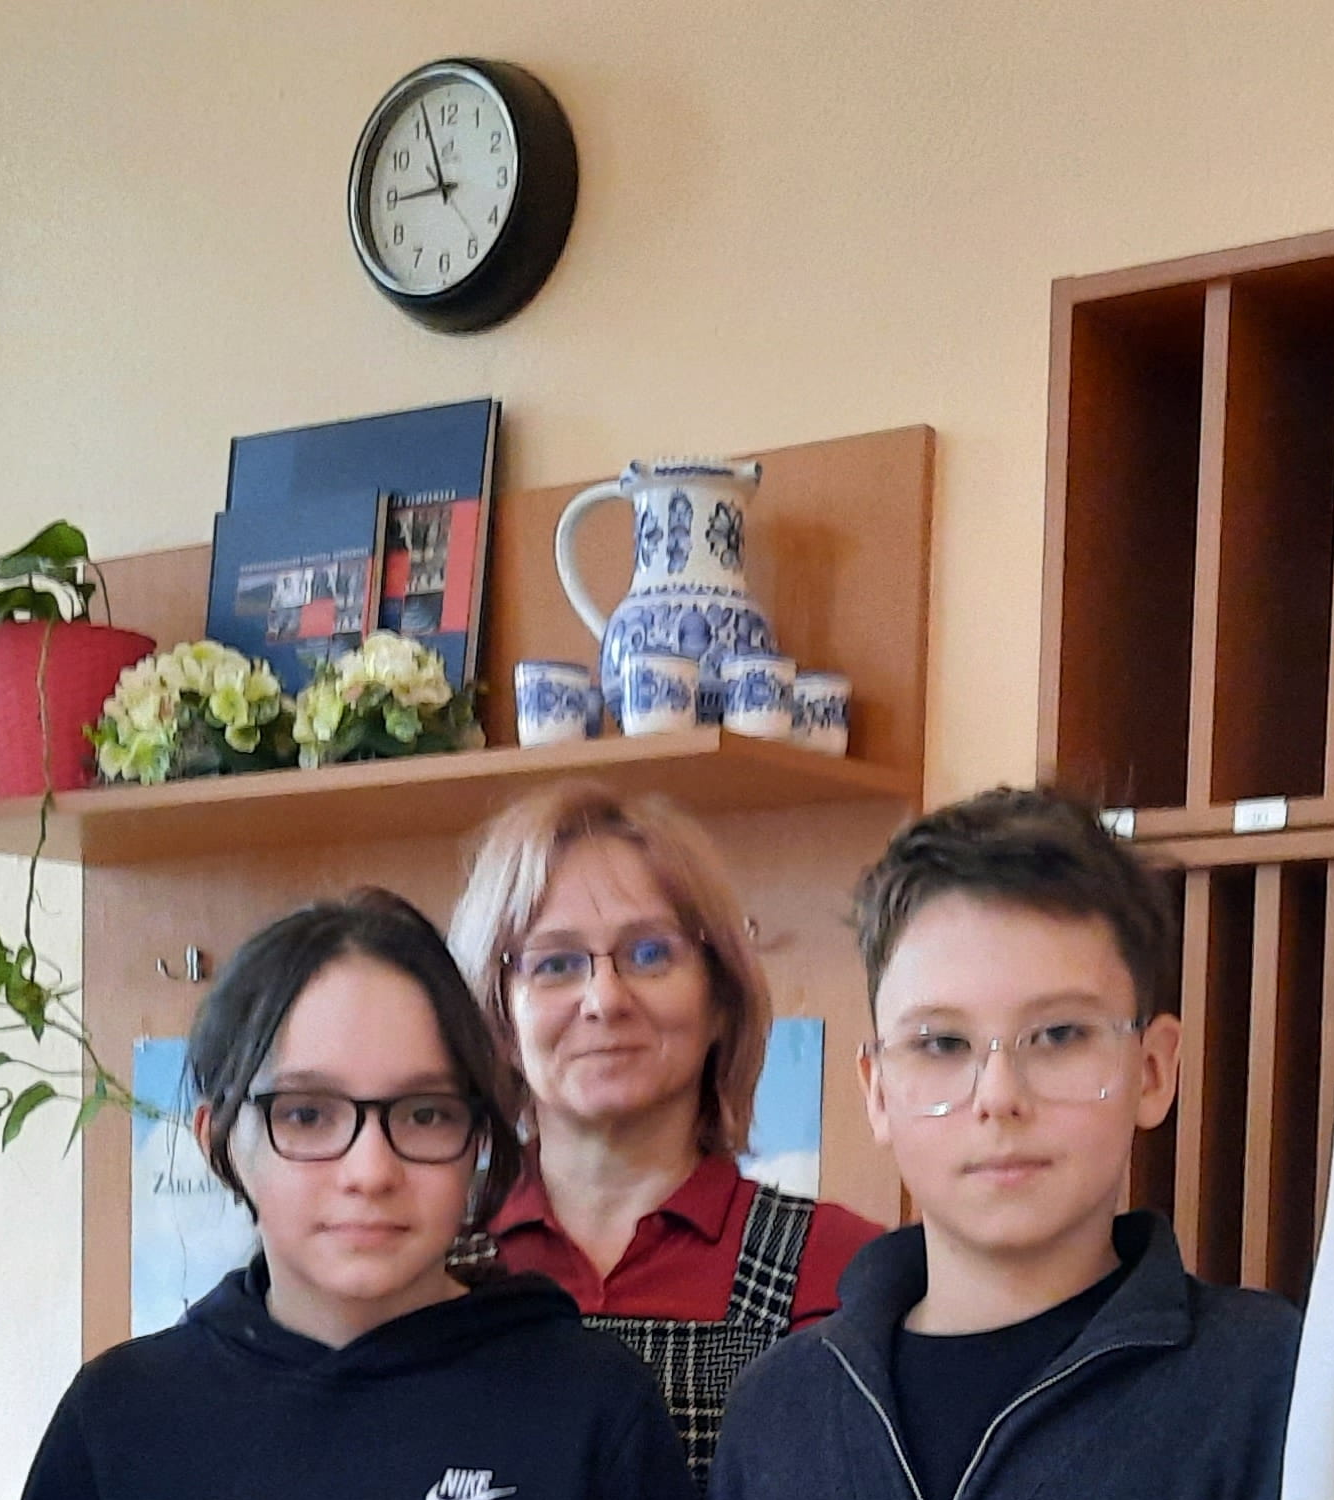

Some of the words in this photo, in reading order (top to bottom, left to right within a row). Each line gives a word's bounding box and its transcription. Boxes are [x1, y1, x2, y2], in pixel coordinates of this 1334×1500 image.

[441, 104, 458, 126] 12
[474, 106, 480, 128] 1
[490, 131, 502, 153] 2
[393, 150, 410, 172] 10
[496, 166, 508, 189] 3
[386, 190, 398, 211] 9
[487, 205, 498, 227] 4
[393, 224, 404, 245] 8
[413, 247, 424, 269] 7
[467, 239, 478, 259] 5
[439, 253, 450, 273] 6
[439, 1467, 494, 1499] NIKE
